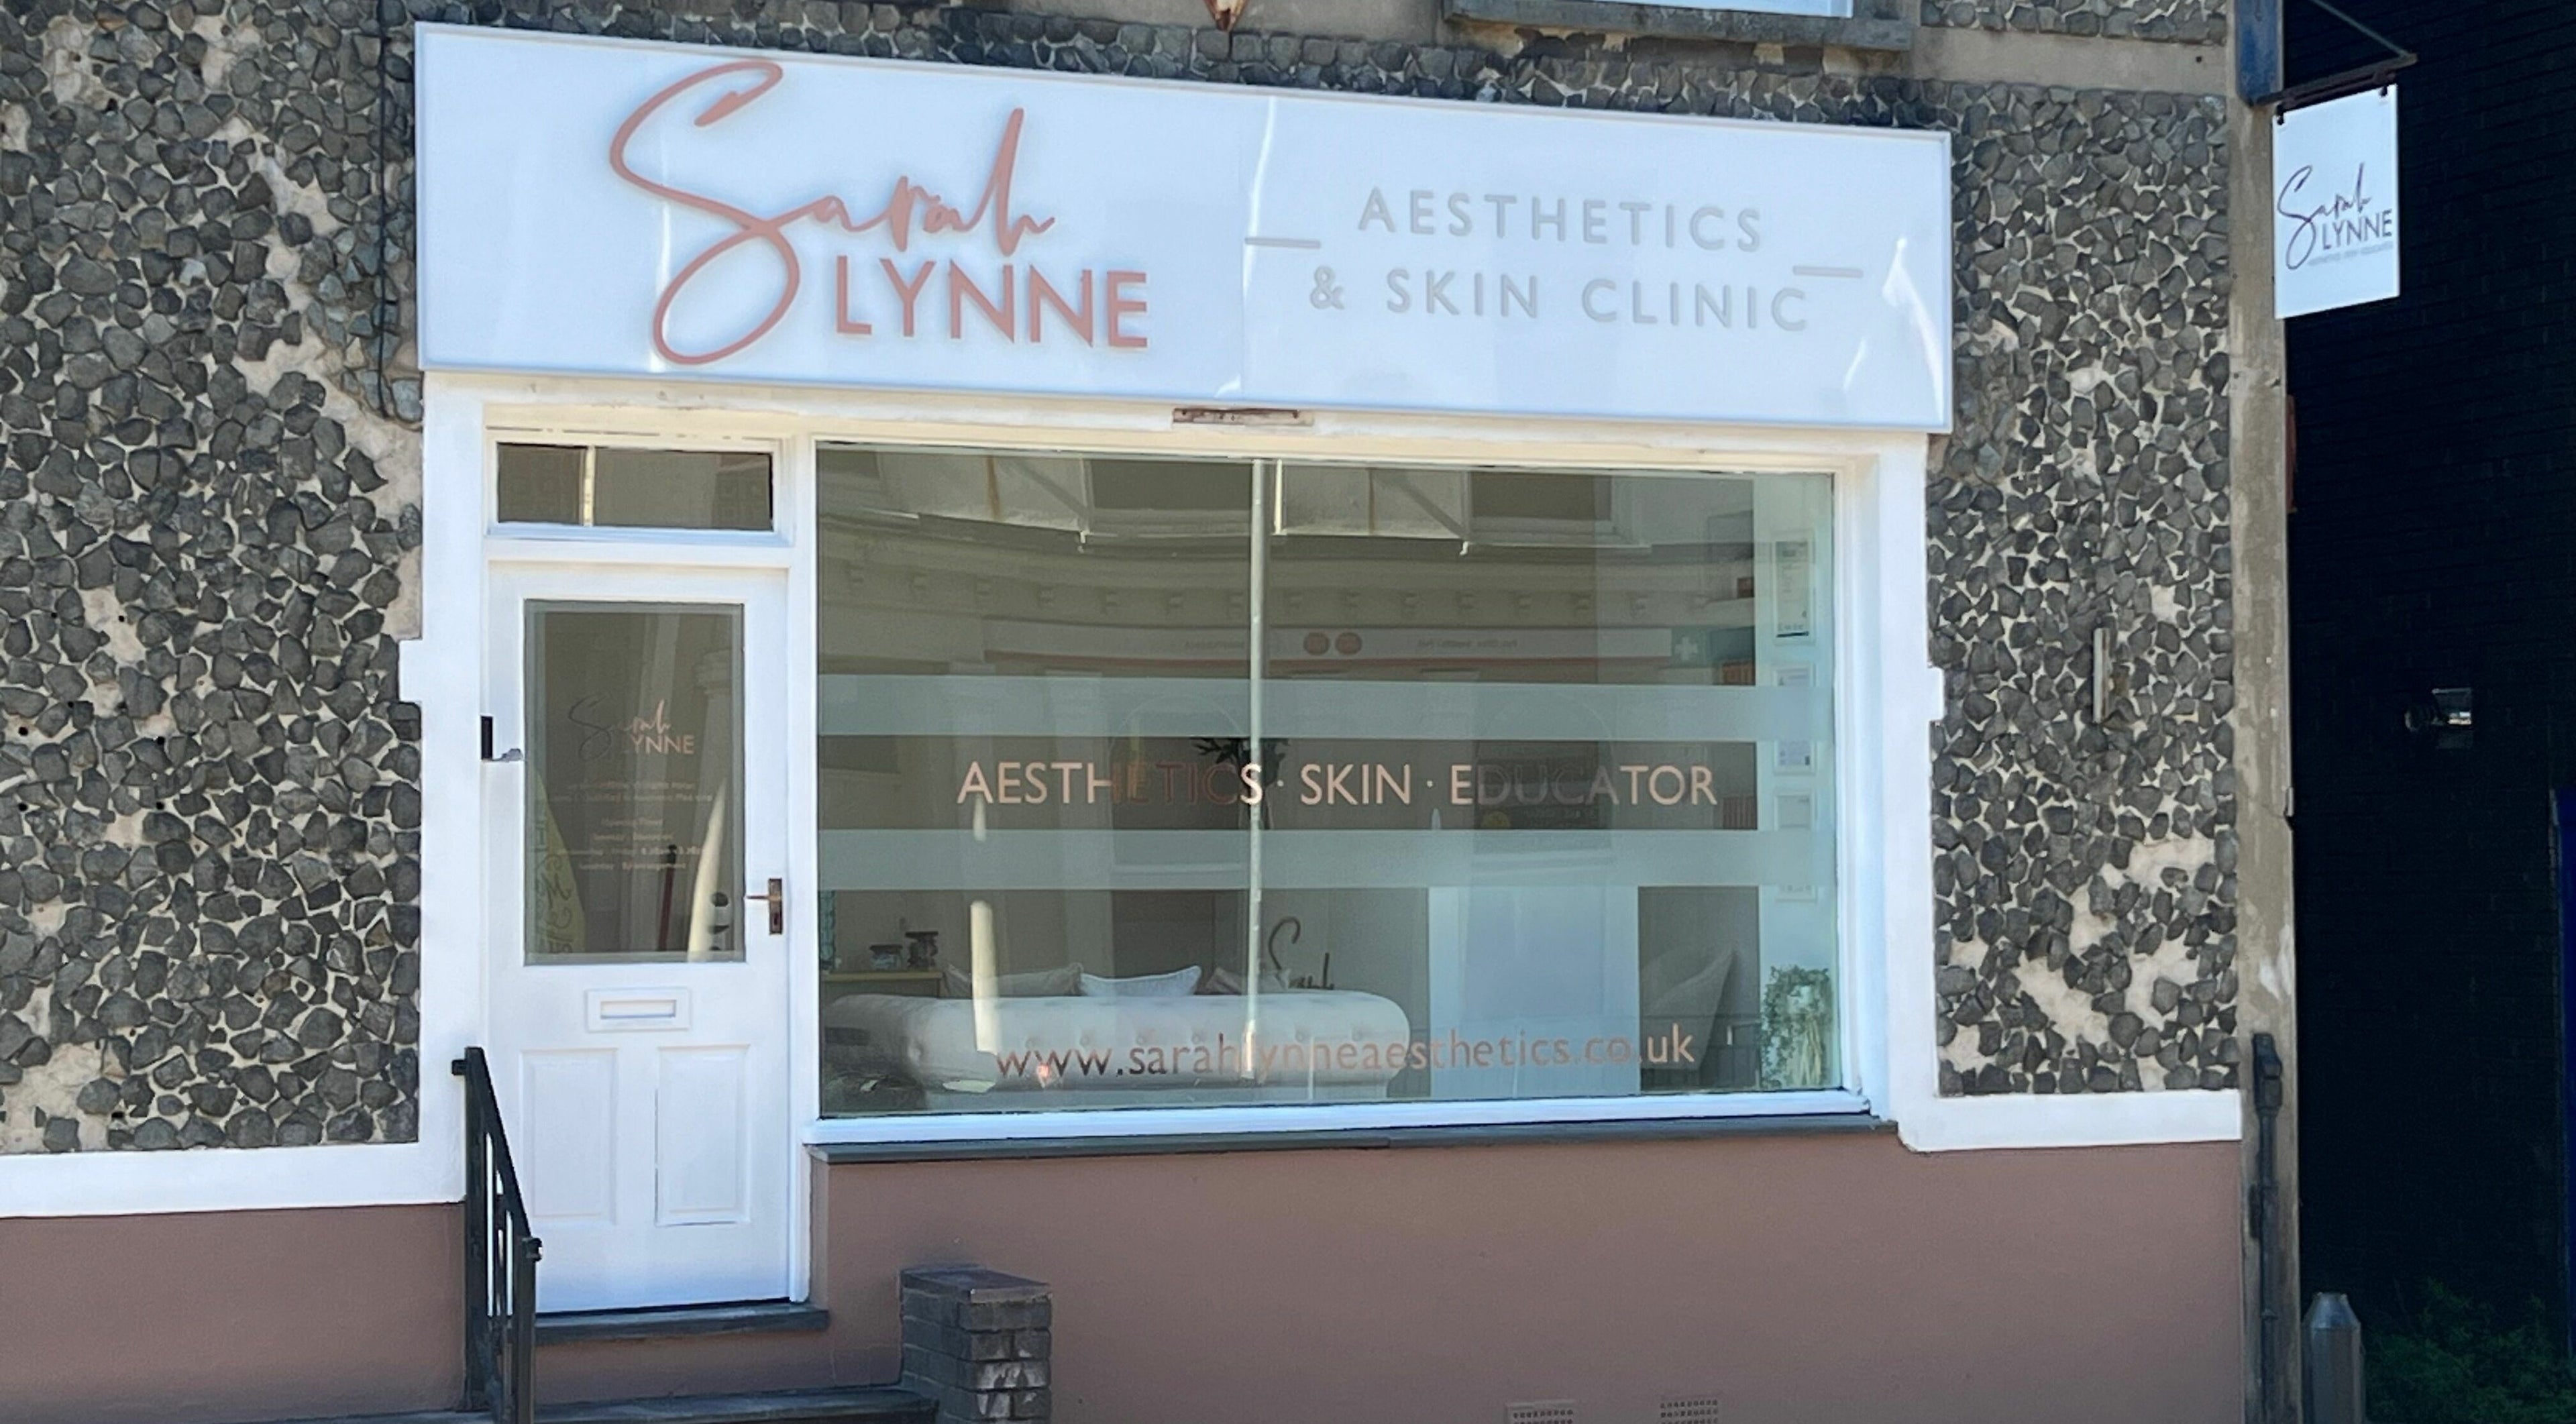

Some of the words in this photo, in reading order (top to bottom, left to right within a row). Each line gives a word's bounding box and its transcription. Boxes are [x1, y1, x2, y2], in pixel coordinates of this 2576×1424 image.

[610, 60, 1056, 365] Sarah
[1358, 187, 1762, 252] AESTHETICS
[2277, 162, 2371, 270] Sarah
[2322, 209, 2392, 250] LYNNE
[837, 256, 1148, 348] LYNNE
[1309, 266, 1345, 311] &
[1386, 269, 1540, 319] SKIN
[1580, 277, 1807, 331] CLINIC
[624, 734, 695, 755] YNNE
[957, 761, 1263, 806] AESTHETICS
[1300, 763, 1411, 806] SKIN
[1450, 764, 1717, 806] EDUCATOR
[998, 1022, 1695, 1081] www.sarahlynneaesthetics.co.uk
